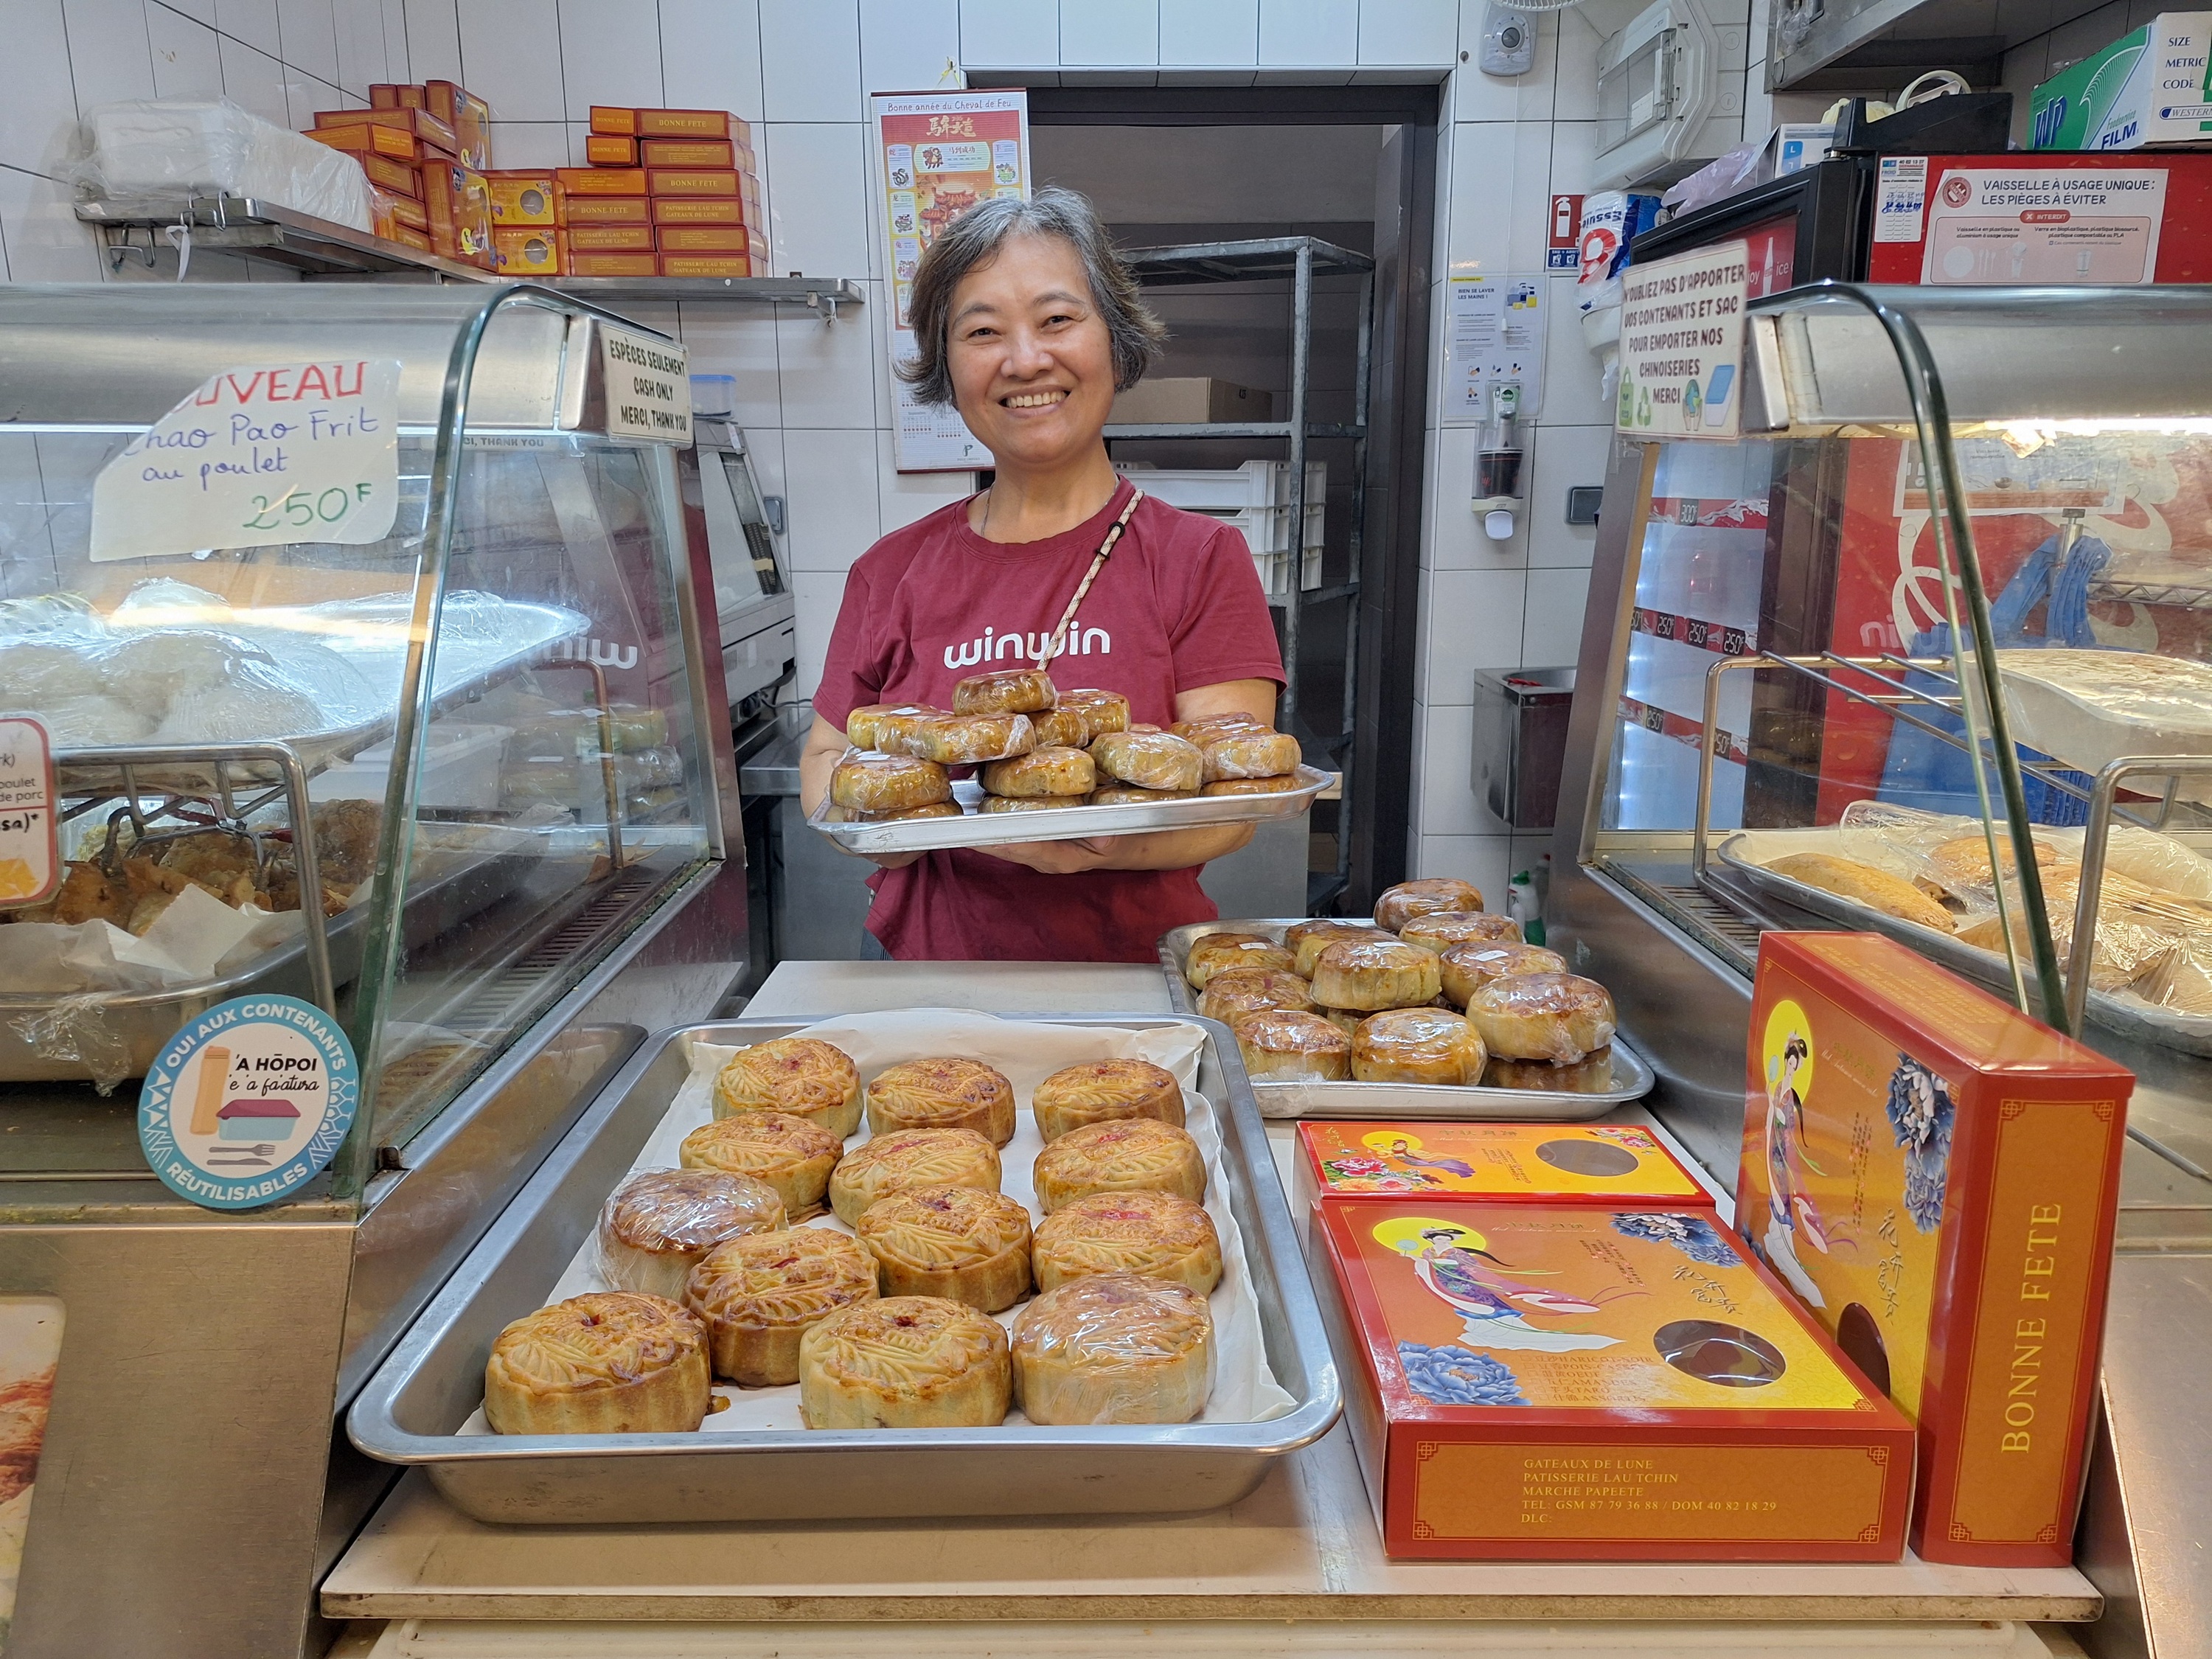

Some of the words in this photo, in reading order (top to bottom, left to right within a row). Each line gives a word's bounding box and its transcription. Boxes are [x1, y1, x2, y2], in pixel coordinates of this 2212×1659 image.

[2168, 37, 2191, 47] SIZE
[2165, 57, 2207, 69] METRIC
[2163, 78, 2194, 89] CODE
[888, 102, 913, 111] Bonne
[915, 102, 939, 111] année
[942, 102, 952, 110] du
[954, 100, 983, 110] Cheval
[985, 100, 994, 108] de
[998, 98, 1012, 108] Feu
[2107, 109, 2137, 131] Foodservice
[2101, 120, 2138, 150] FILM
[1790, 145, 1796, 153] L
[1983, 180, 2051, 190] VAISSELLE
[2052, 178, 2061, 190] À
[2062, 180, 2104, 190] USAGE
[1981, 195, 2005, 205] LES
[2007, 192, 2051, 205] PIÈGES
[2052, 192, 2061, 205] À
[2063, 192, 2107, 204] ÉVITER
[1775, 261, 1789, 276] ice
[1659, 277, 1676, 295] PAS
[1679, 264, 1745, 293] D'APPORTER
[1624, 311, 1637, 328] VOS
[1638, 302, 1696, 327] CONTENANTS
[1699, 299, 1712, 318] ET
[1715, 295, 1738, 315] SAC
[1629, 338, 1648, 352] POUR
[1650, 330, 1697, 351] EMPORTER
[1700, 327, 1723, 346] NOS
[609, 336, 646, 366] ESPÈCES
[647, 350, 686, 377] SEULEMENT
[1639, 358, 1700, 378] CHINOISERIES
[633, 376, 655, 398] CASH
[655, 380, 673, 401] ONLY
[1652, 388, 1680, 403] MERCI
[231, 414, 299, 445] Pao
[308, 407, 379, 442] Frit
[620, 405, 650, 430] MERCI,
[650, 409, 675, 429] THANK
[675, 411, 686, 431] YOU
[481, 437, 518, 446] THANK
[521, 438, 544, 447] YOU
[142, 467, 184, 481] au
[201, 447, 289, 491] poulet
[944, 620, 1110, 669] winwin
[1657, 615, 1674, 636] 250F
[1688, 622, 1708, 644] 250F
[1724, 632, 1745, 655] 250F
[15, 790, 44, 803] porc
[166, 1034, 196, 1068] OUI
[197, 1008, 238, 1038] AUX
[241, 1003, 347, 1071] CONTENANTS
[255, 1053, 318, 1071] HŌPOI
[166, 1161, 308, 1201] RÉUTILISABLES
[2021, 1203, 2062, 1301] FETE
[2001, 1318, 2047, 1453] BONNE
[1523, 1458, 1589, 1470] GATEAUX
[1593, 1459, 1612, 1470] DE
[1616, 1459, 1653, 1470] LUNE
[1523, 1472, 1599, 1483] PATISSERIE
[1603, 1473, 1631, 1483] LAU
[1637, 1473, 1679, 1484] TCHIN
[1522, 1486, 1580, 1497] MARCHE
[1585, 1486, 1644, 1497] PAPEETE
[1521, 1500, 1551, 1510] TEL:
[1555, 1500, 1585, 1510] GSM
[1589, 1500, 1603, 1510] 87
[1608, 1500, 1622, 1511] 79
[1626, 1500, 1641, 1511] 36
[1644, 1500, 1659, 1511] 88
[1662, 1500, 1668, 1512] /
[1671, 1500, 1703, 1511] DOM
[1706, 1500, 1721, 1511] 40
[1725, 1501, 1739, 1511] 82
[1745, 1501, 1758, 1512] 18
[1761, 1501, 1777, 1512] 29
[1520, 1513, 1552, 1523] DLC:
